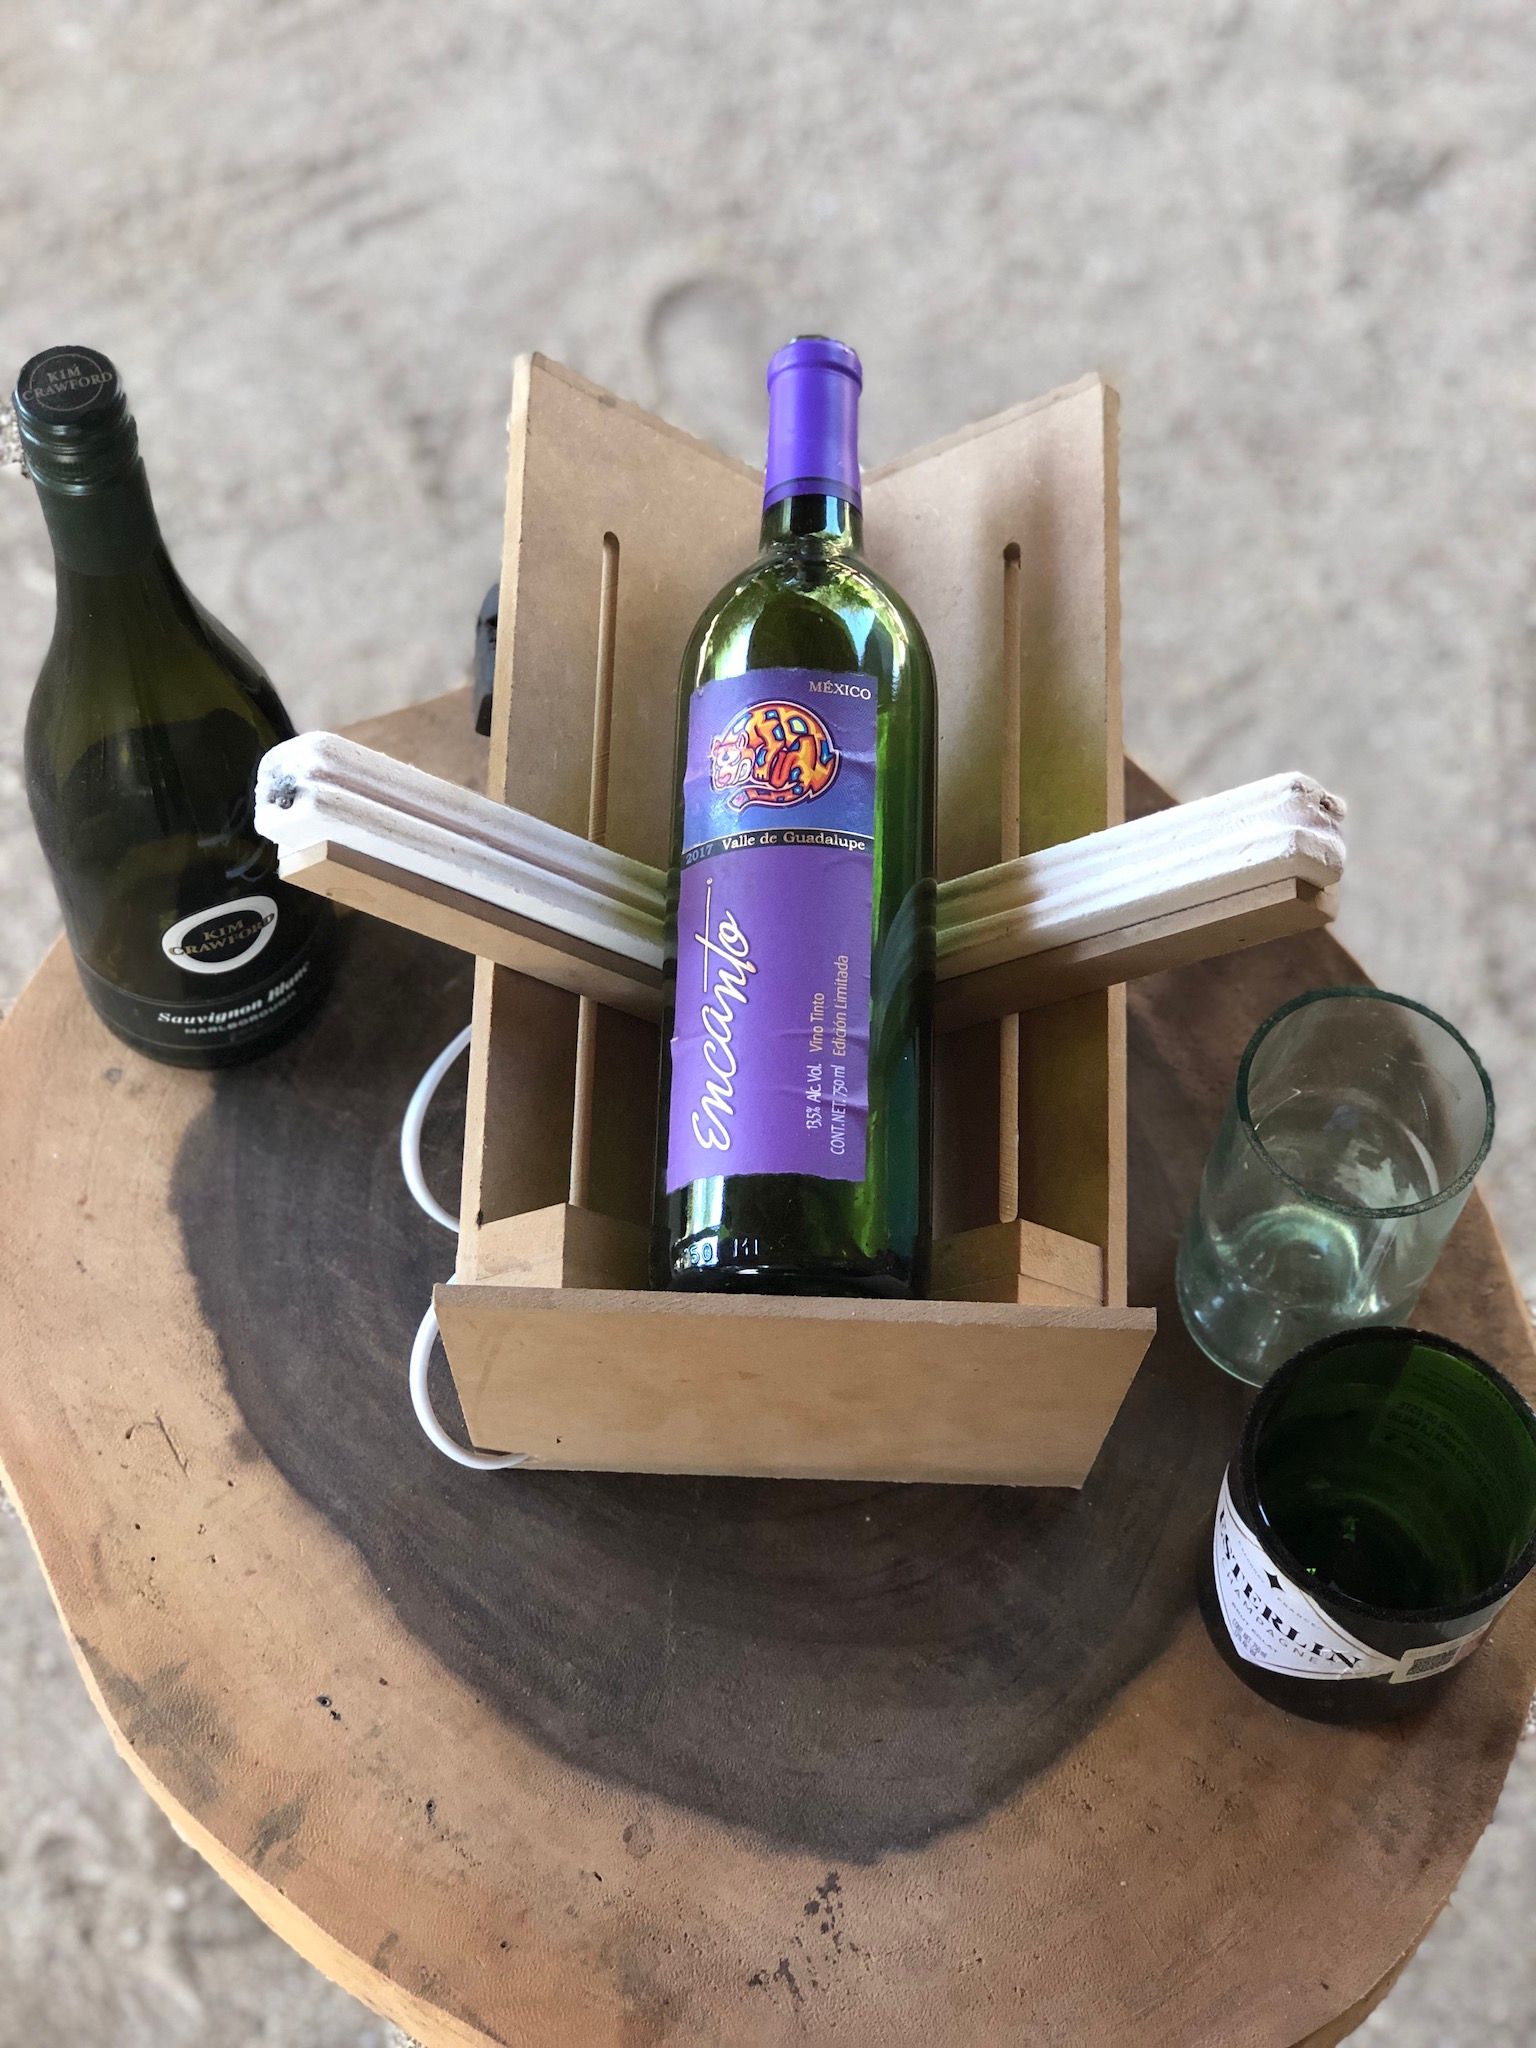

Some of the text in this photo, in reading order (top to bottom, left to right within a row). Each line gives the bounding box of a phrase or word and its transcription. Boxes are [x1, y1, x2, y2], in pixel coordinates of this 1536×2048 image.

[21, 371, 113, 402] CRAWFORD
[47, 364, 81, 383] KIM
[809, 680, 872, 700] MÉXICO
[685, 831, 865, 865] 2017 Valle de Guadalupe
[168, 912, 275, 955] CRAWFORD
[203, 919, 244, 941] KIM
[157, 999, 263, 1025] Sauvignon
[691, 877, 757, 1151] Encanto
[832, 955, 849, 1057] Edición Limitada
[809, 992, 825, 1053] Vino Tinto
[831, 1064, 845, 1078] ml
[833, 1079, 848, 1097] 750
